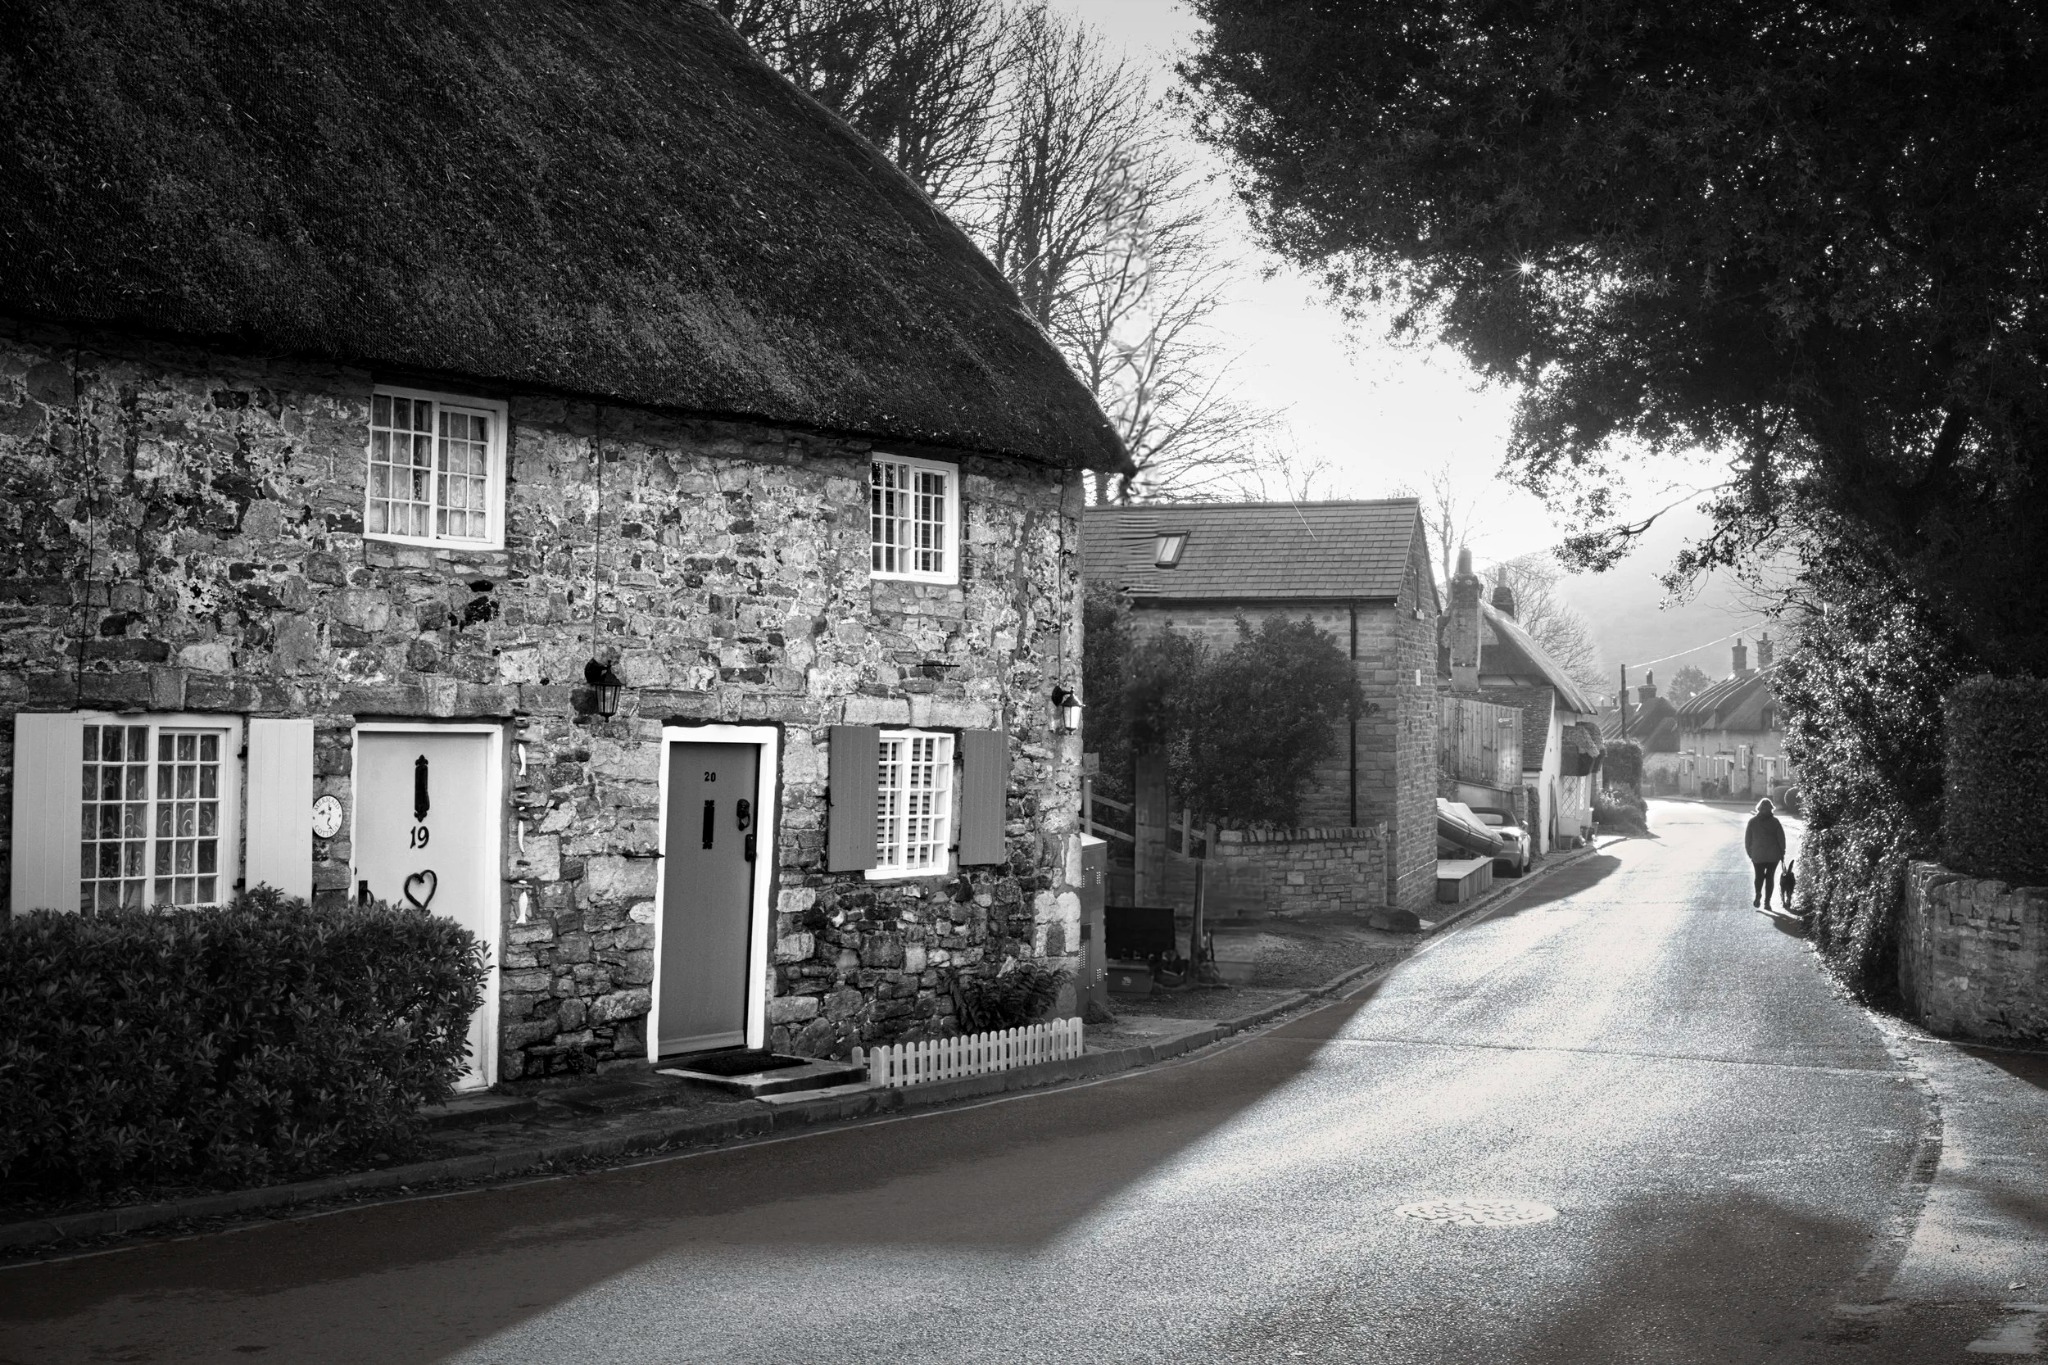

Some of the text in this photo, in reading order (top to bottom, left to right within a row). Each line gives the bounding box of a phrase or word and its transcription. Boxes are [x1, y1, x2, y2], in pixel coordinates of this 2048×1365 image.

[704, 771, 717, 783] 20
[314, 796, 341, 811] MERMAID
[314, 824, 340, 837] COTTAGE
[409, 826, 430, 849] 19
